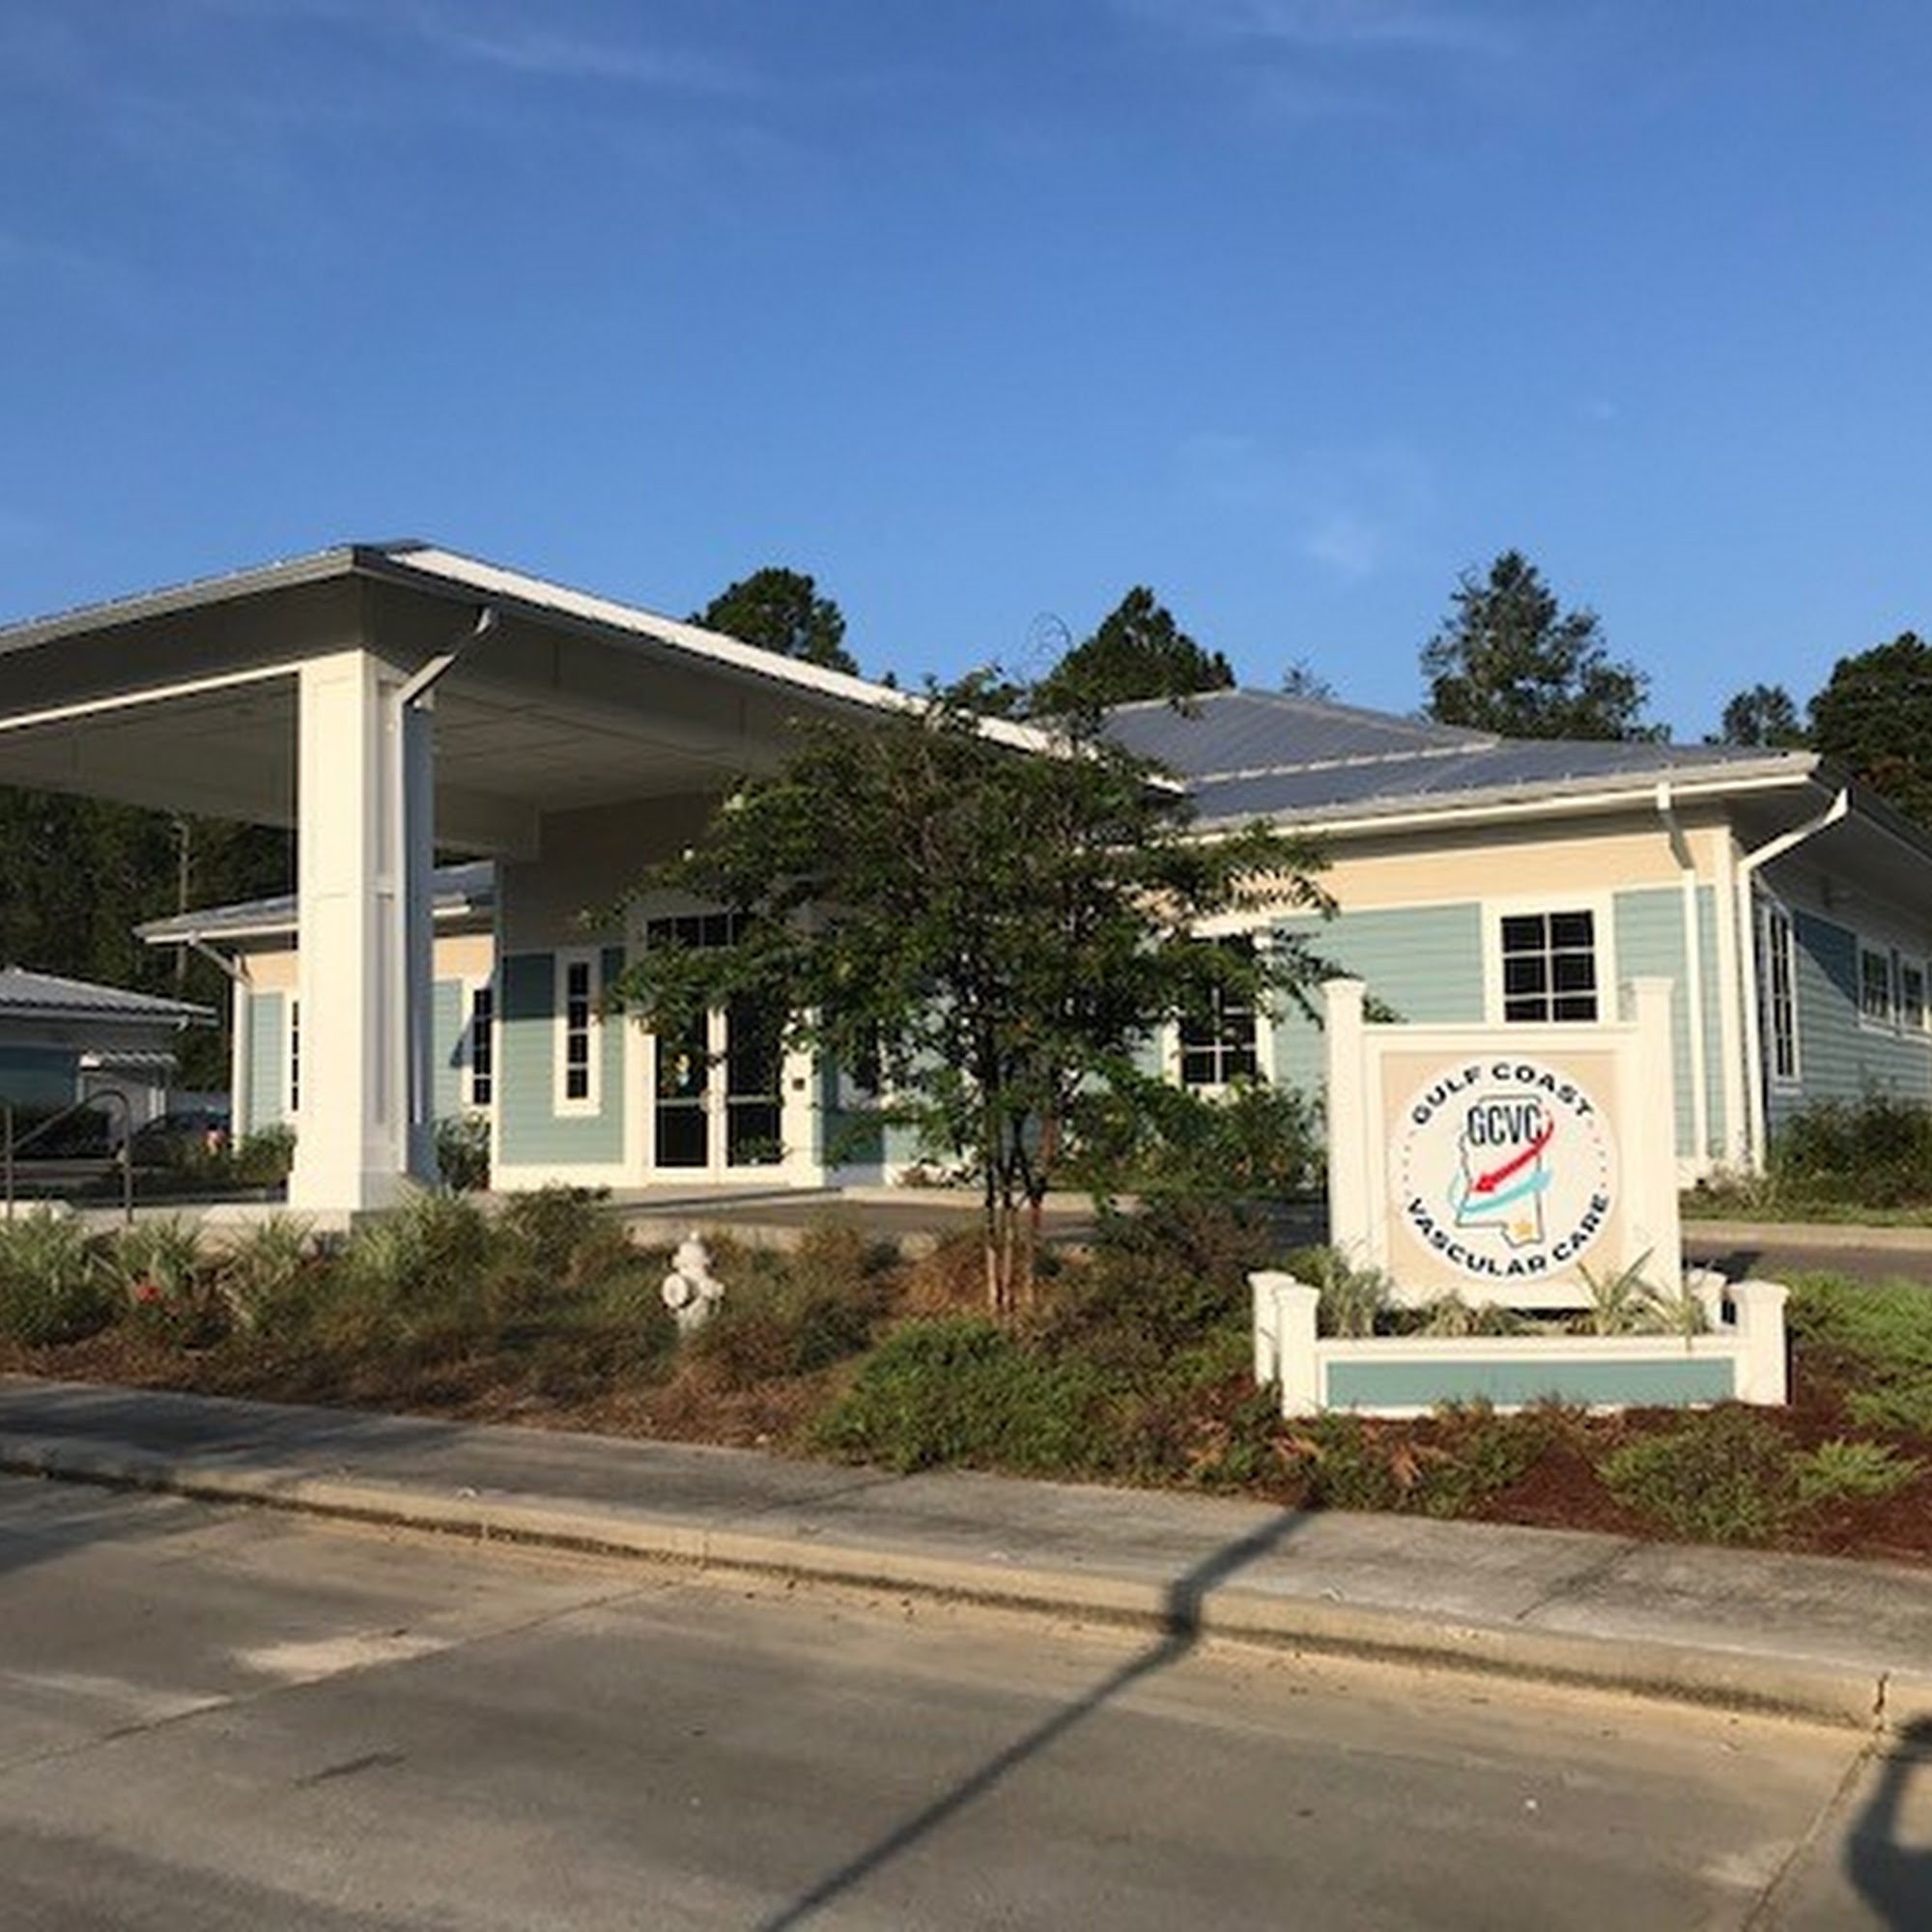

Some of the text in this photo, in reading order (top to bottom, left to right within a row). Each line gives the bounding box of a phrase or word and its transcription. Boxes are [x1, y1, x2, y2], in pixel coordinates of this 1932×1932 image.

[1411, 1063, 1594, 1125] GULF COAST
[1466, 1103, 1543, 1147] GCVC
[1407, 1194, 1609, 1276] VASCULAR CARE
